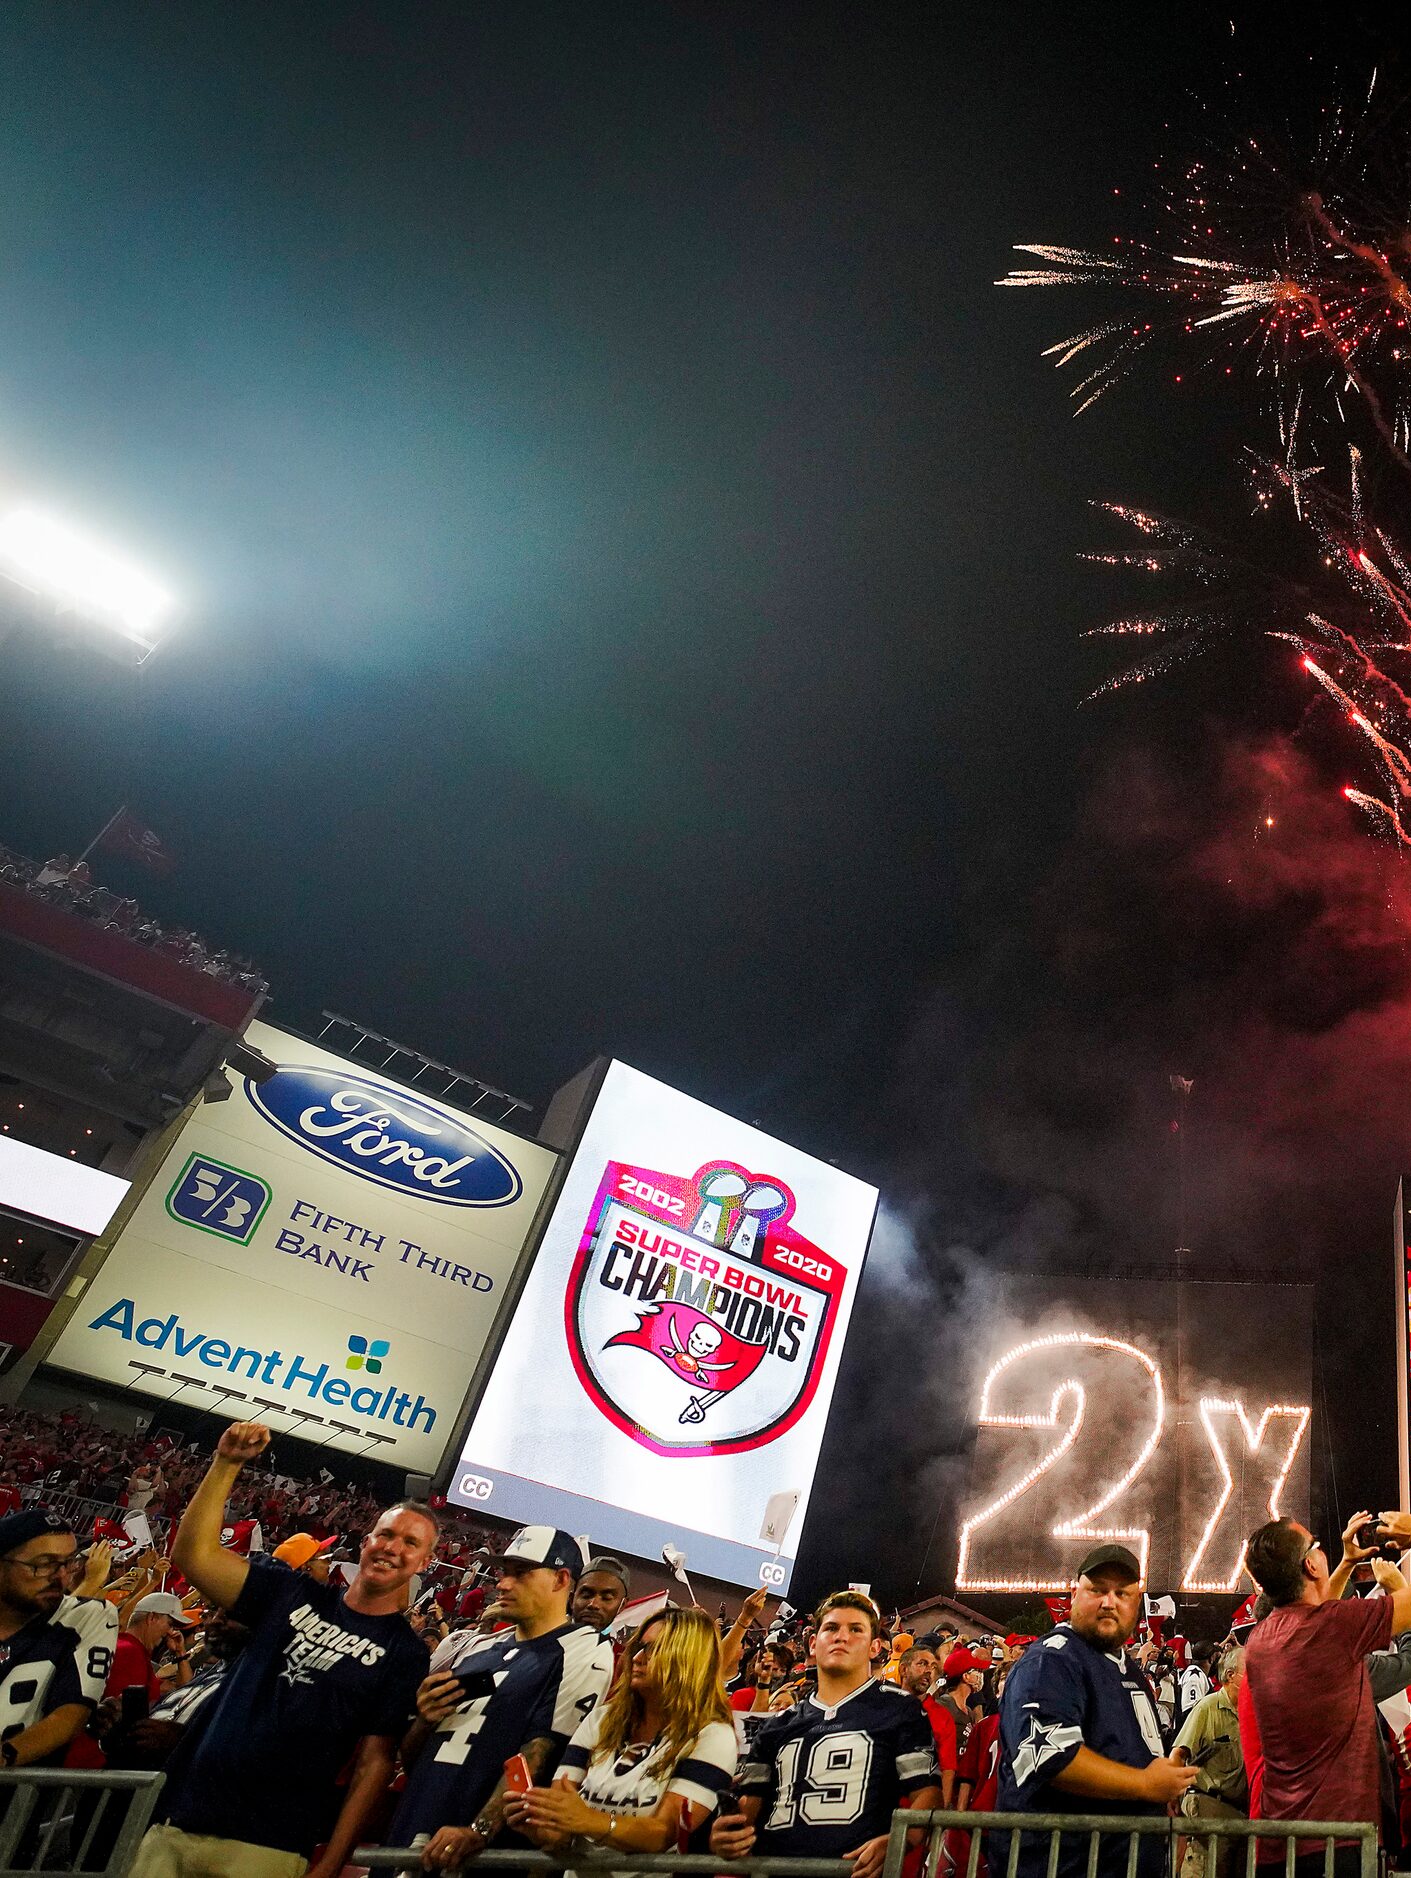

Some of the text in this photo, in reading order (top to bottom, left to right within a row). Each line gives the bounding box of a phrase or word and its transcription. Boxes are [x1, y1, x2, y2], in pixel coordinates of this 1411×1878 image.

[299, 1090, 475, 1190] Ford
[618, 1175, 686, 1217] 2002
[274, 1230, 374, 1282] BANK
[289, 1200, 494, 1293] FIFTH THIRD
[615, 1219, 809, 1319] SUPER BOWL
[773, 1244, 832, 1282] 2020
[600, 1241, 806, 1363] CHAMPIONS
[89, 1299, 437, 1435] AdventHealth
[462, 1477, 491, 1497] CC
[761, 1565, 783, 1582] CC
[282, 1631, 345, 1671] TEAM
[288, 1603, 387, 1666] AMERICA'S
[764, 1729, 874, 1831] 19
